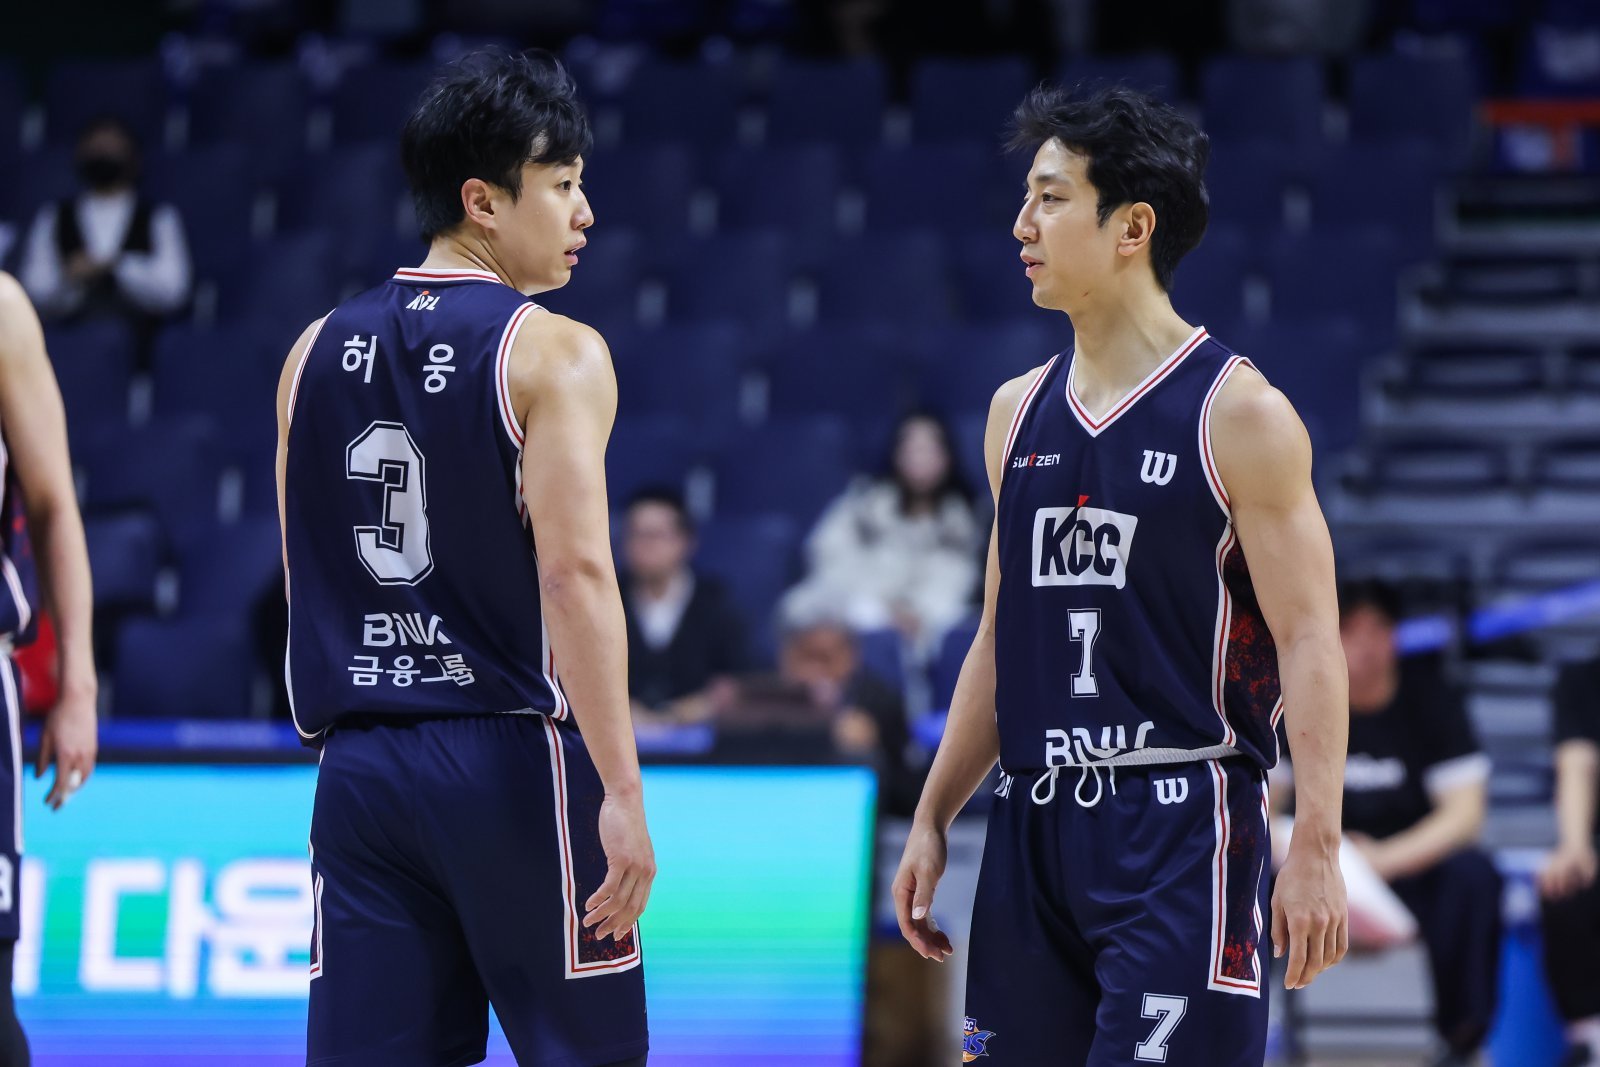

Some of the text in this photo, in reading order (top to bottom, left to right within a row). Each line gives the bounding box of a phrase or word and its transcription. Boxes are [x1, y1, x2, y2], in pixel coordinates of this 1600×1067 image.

[346, 420, 434, 586] 3
[1038, 507, 1122, 577] KCC
[347, 653, 476, 688] 금융그룹
[1067, 608, 1102, 698] 7
[1134, 992, 1189, 1064] 7
